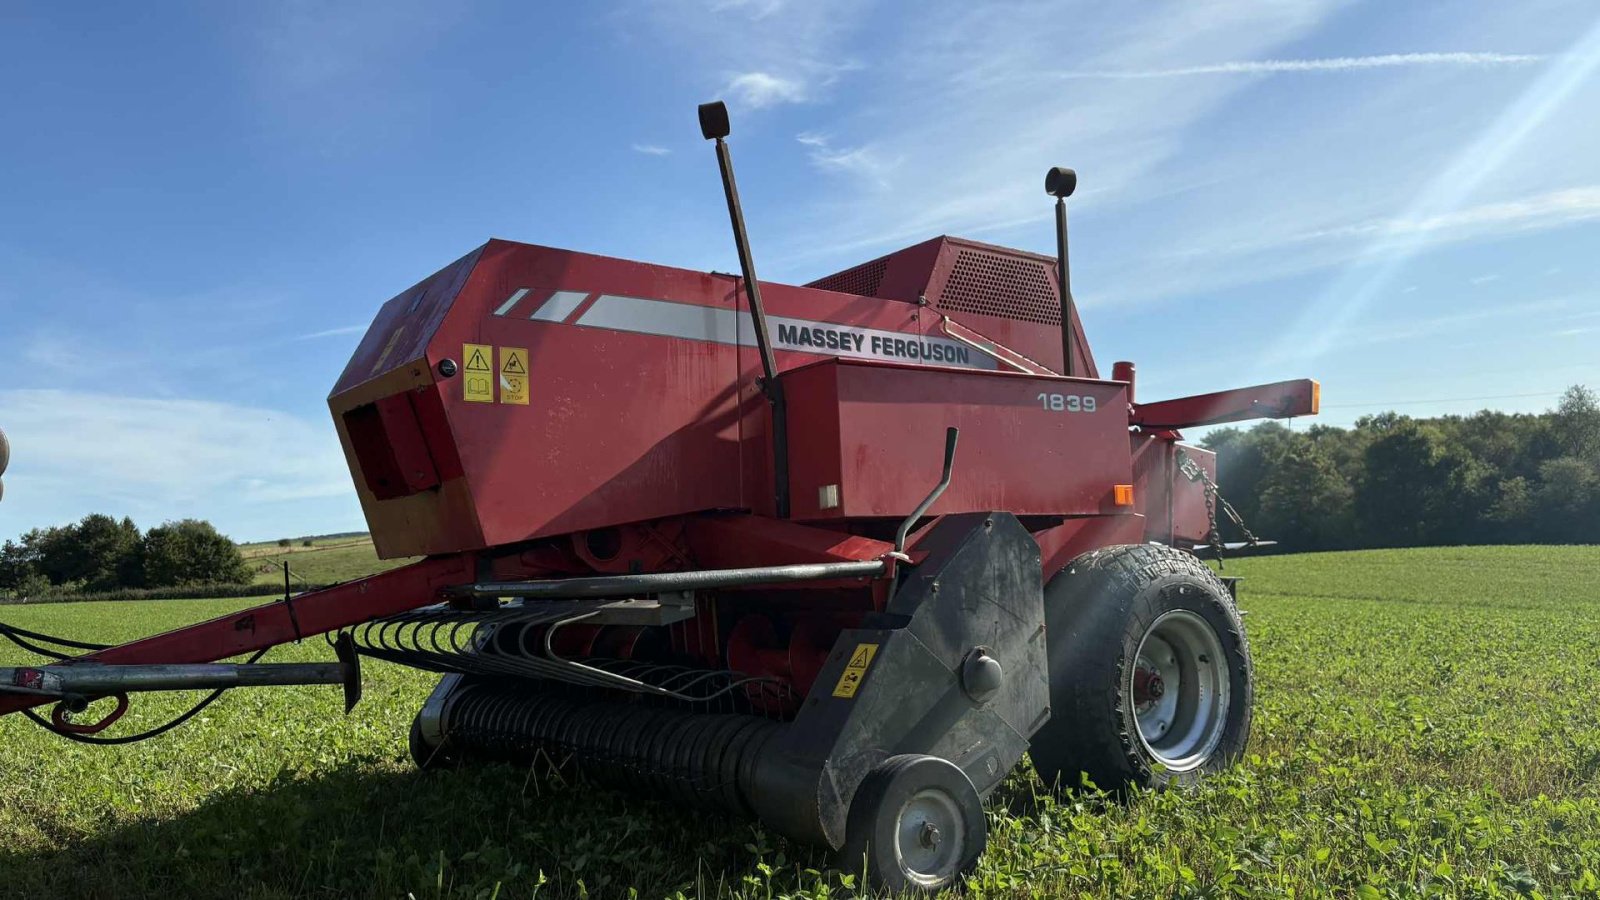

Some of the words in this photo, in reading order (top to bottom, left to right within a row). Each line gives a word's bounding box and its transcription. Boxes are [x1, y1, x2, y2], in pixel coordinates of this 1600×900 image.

[778, 324, 864, 352] MASSEY
[871, 336, 969, 364] FERGUSON
[1037, 393, 1096, 412] 1839
